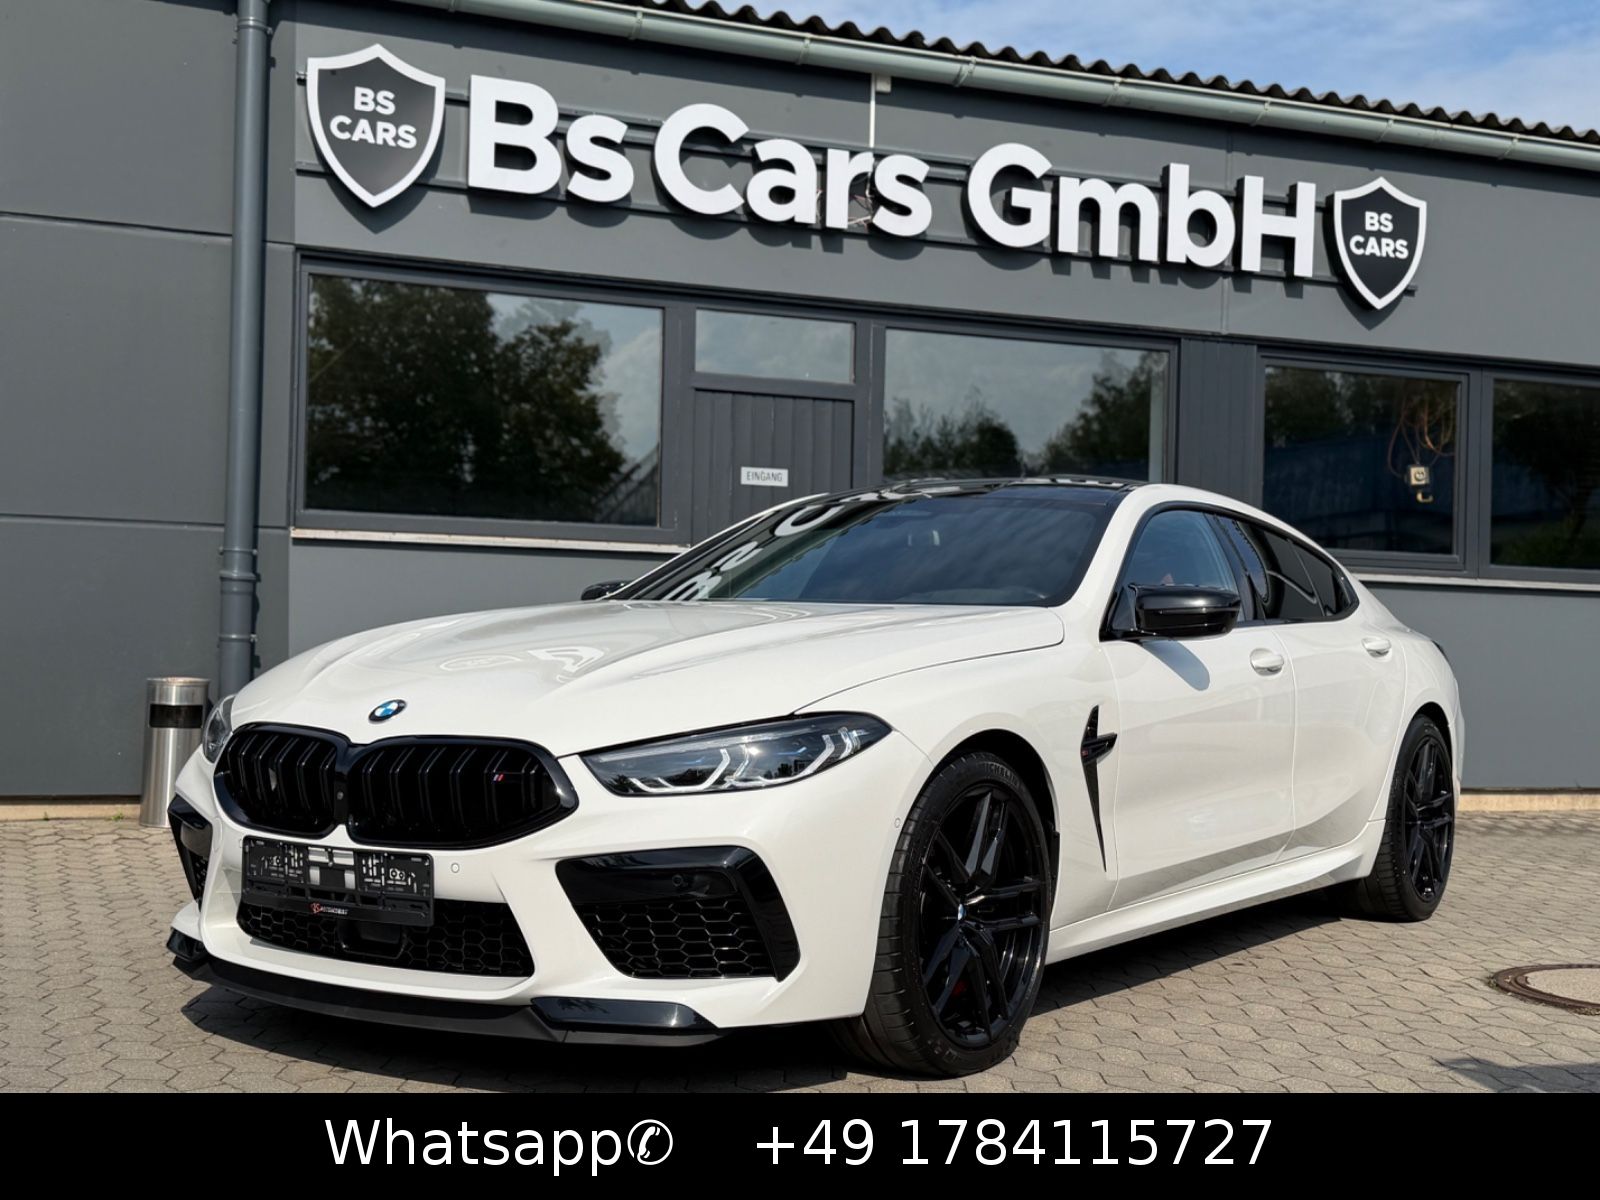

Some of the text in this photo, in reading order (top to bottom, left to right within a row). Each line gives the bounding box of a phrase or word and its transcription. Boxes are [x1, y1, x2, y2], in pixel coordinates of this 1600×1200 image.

[354, 86, 396, 115] BS
[329, 115, 418, 149] CARS
[468, 74, 1317, 278] Bs Cars GmbH
[1364, 211, 1394, 233] BS
[1349, 234, 1409, 260] CARS
[746, 471, 783, 482] EINGANG
